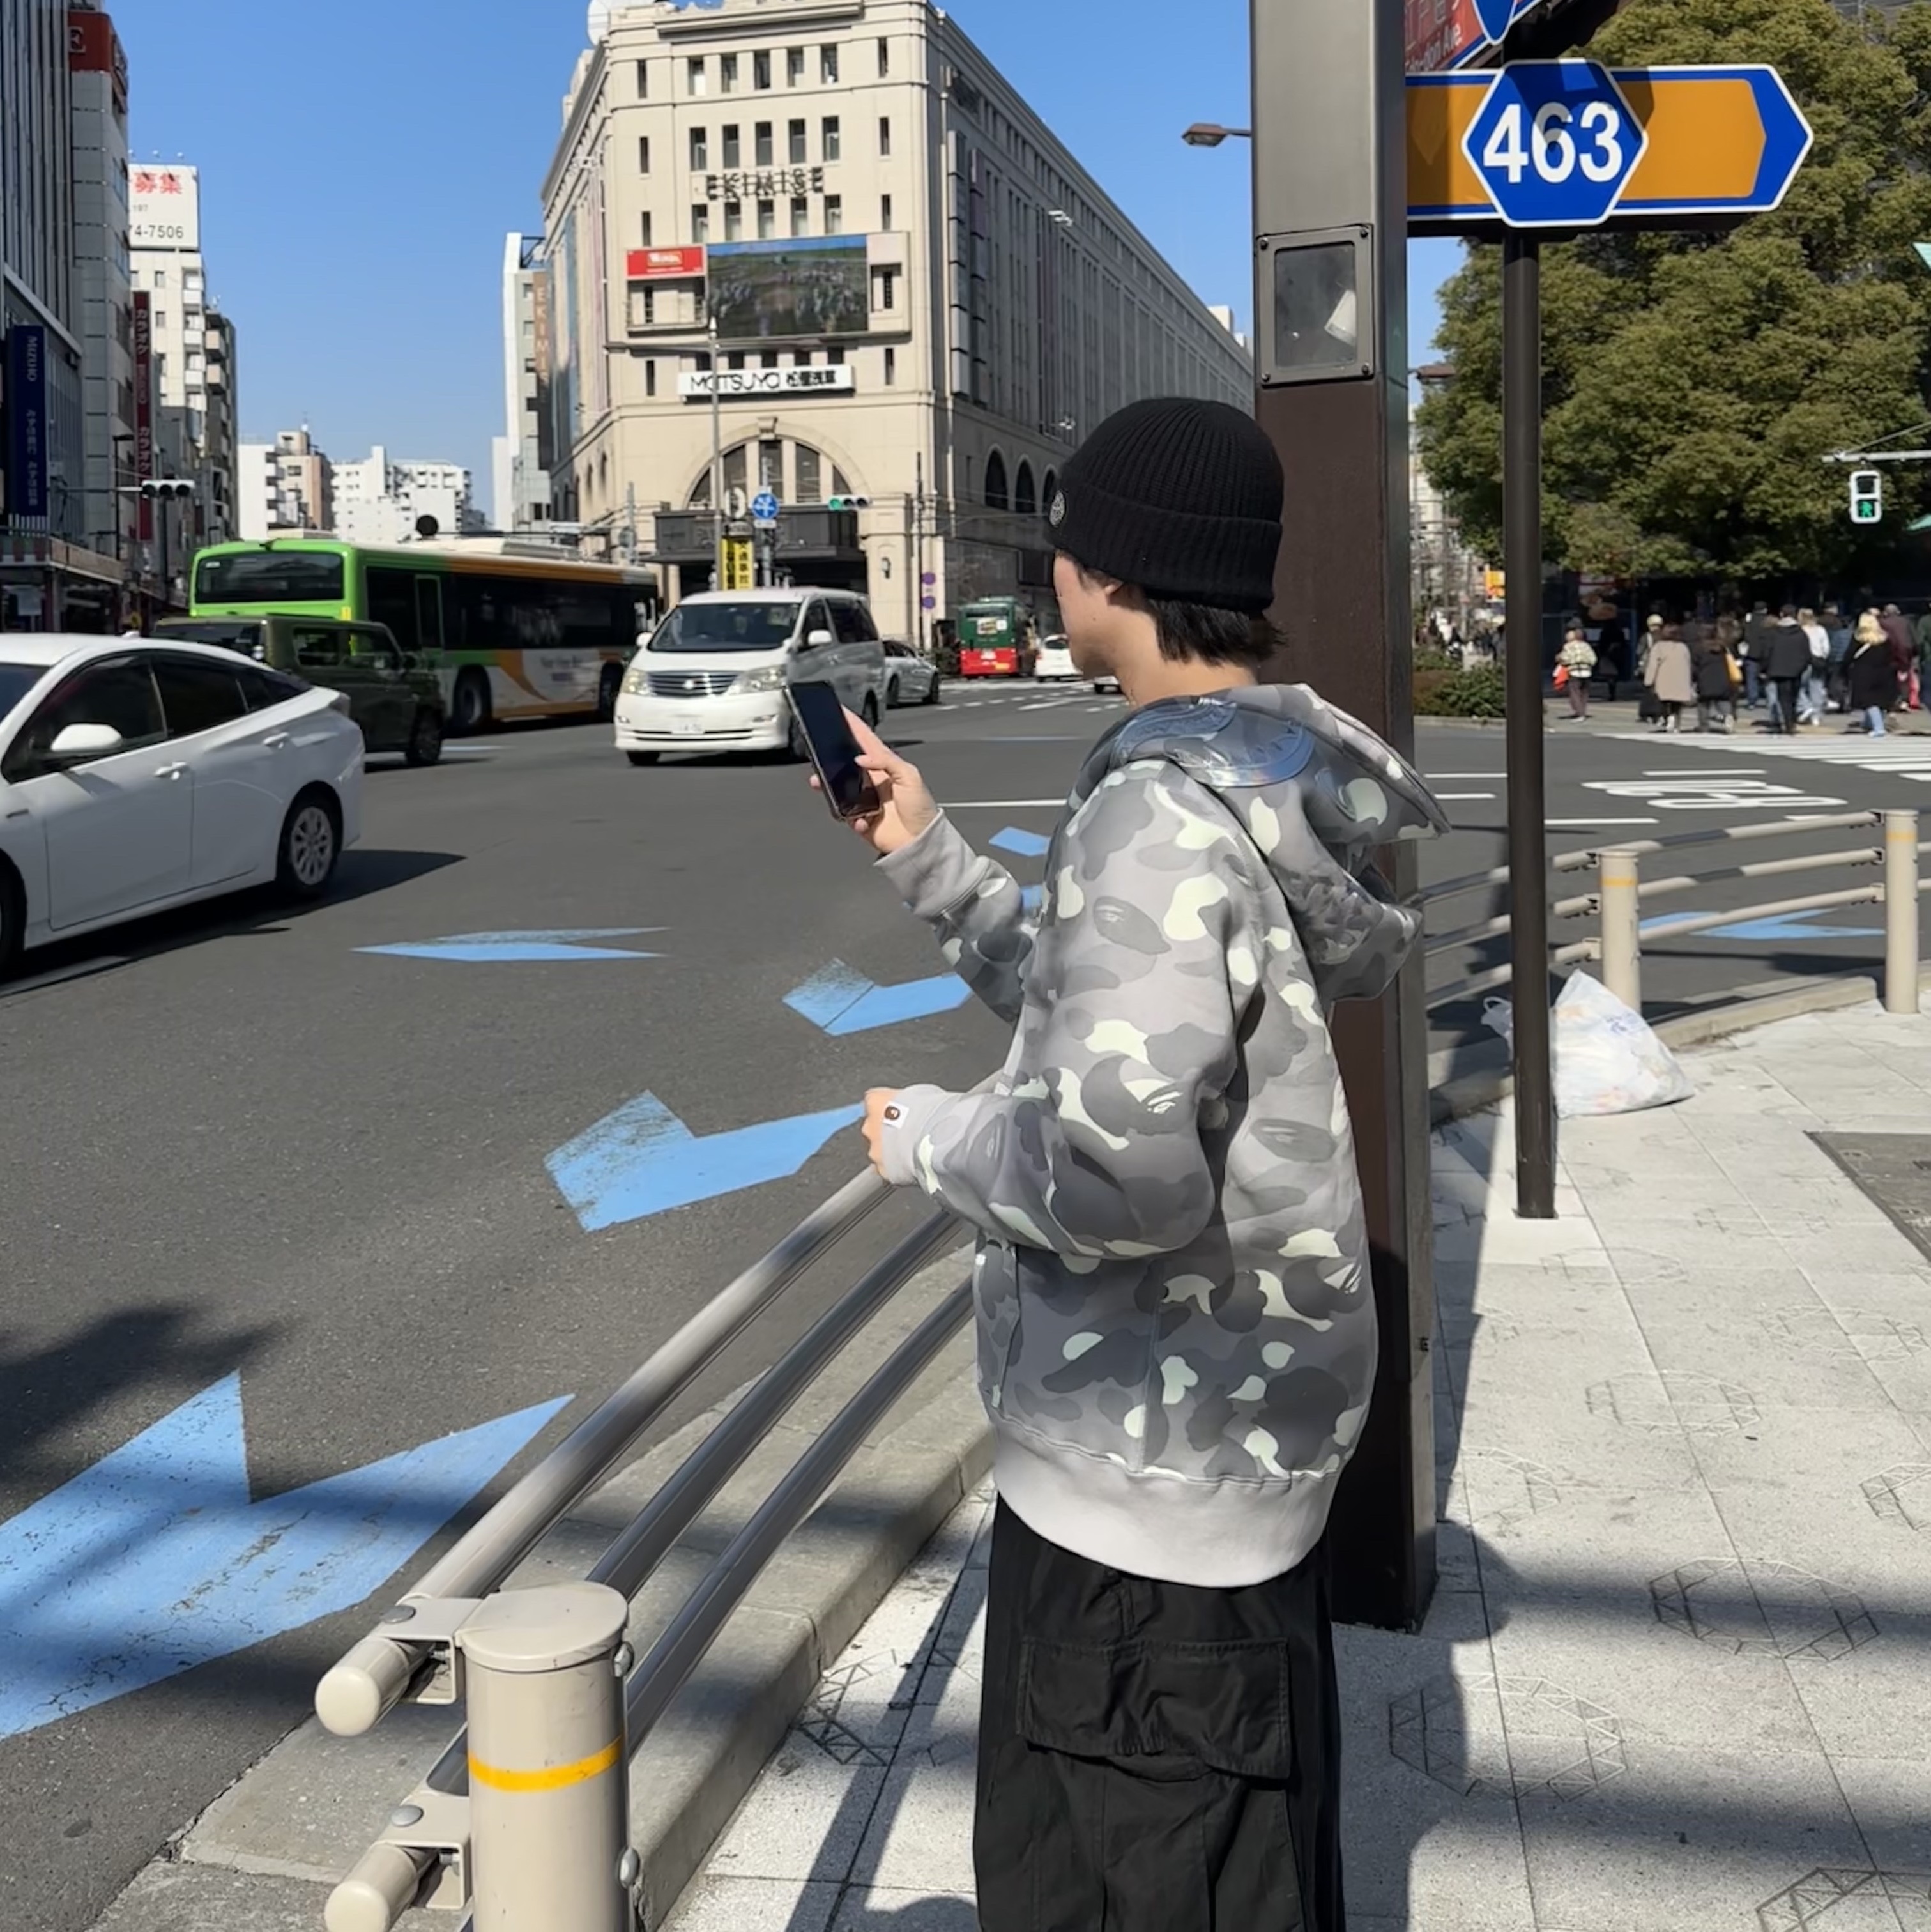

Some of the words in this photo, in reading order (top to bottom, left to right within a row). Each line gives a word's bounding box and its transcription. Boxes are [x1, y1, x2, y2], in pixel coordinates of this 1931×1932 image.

[1483, 101, 1622, 183] 463
[134, 171, 182, 194] 募集
[706, 167, 823, 201] EKIMISE
